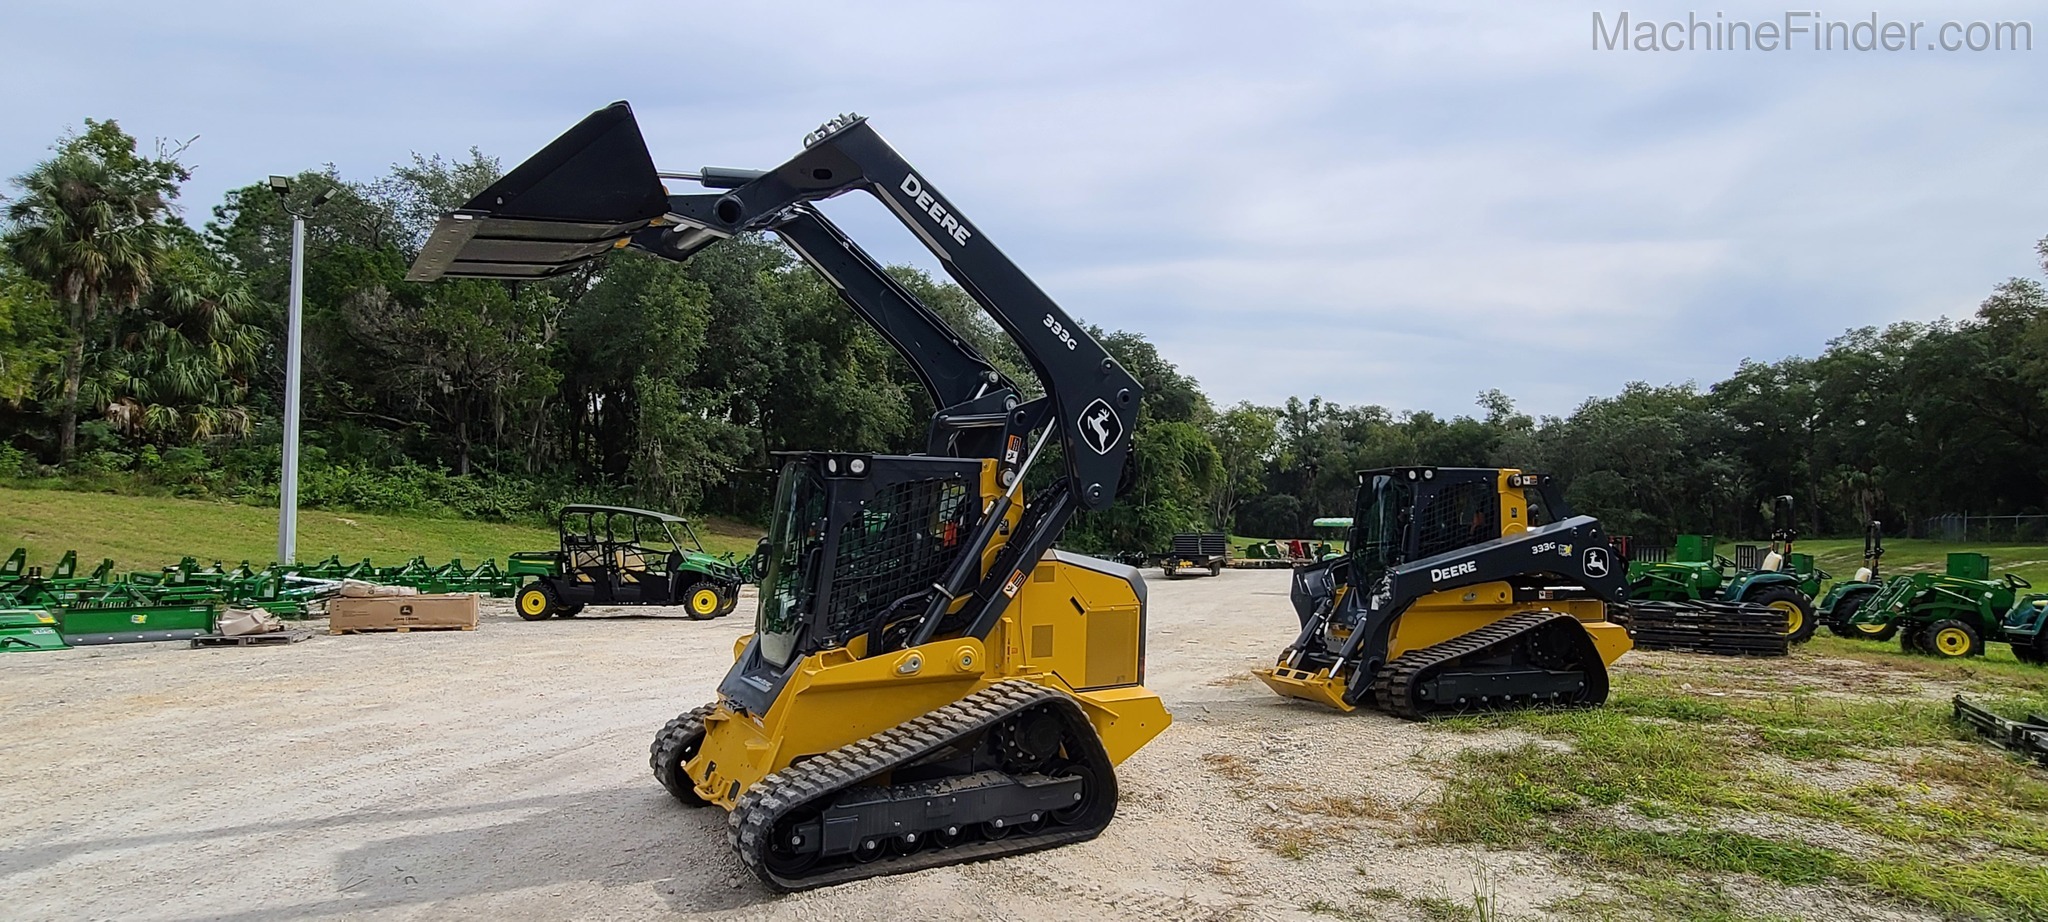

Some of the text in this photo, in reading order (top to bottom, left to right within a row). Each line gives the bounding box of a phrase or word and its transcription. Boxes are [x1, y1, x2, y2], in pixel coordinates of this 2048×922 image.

[900, 173, 971, 246] DEERE
[1042, 314, 1078, 351] 333G
[1532, 542, 1556, 556] 333G
[1431, 561, 1477, 583] DEERE
